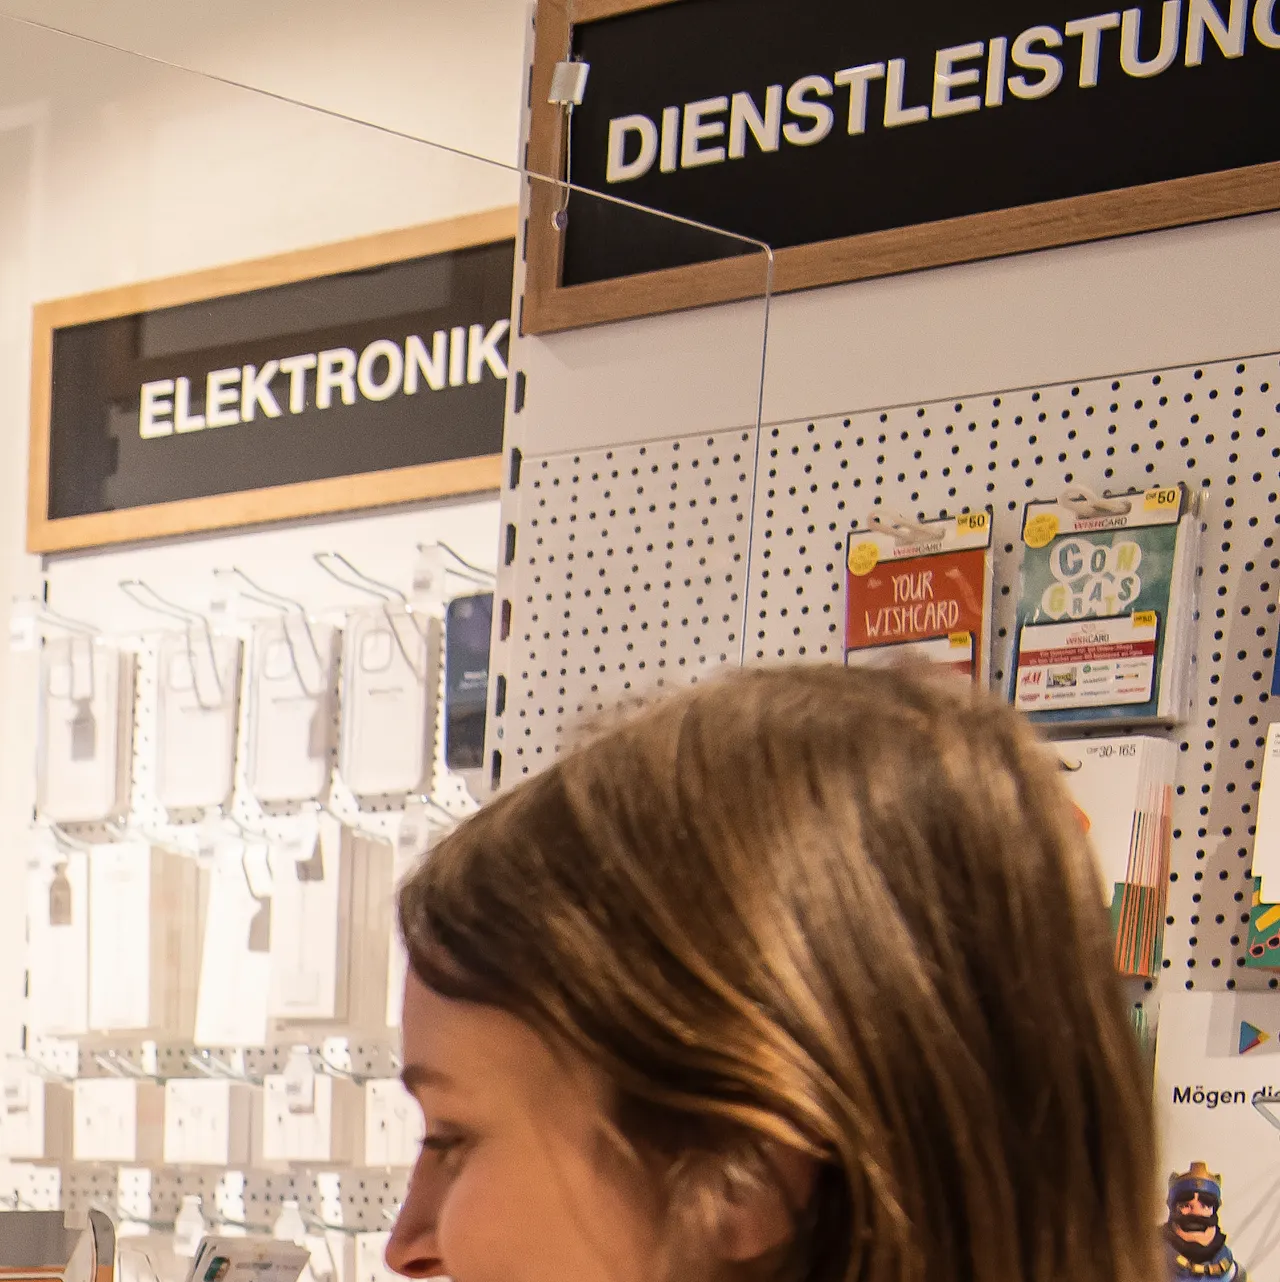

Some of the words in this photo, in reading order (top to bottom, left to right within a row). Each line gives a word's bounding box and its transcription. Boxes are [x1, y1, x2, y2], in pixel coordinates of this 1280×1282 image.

[138, 318, 513, 441] ELEKTRONIK
[1158, 490, 1176, 504] 50
[1074, 517, 1127, 530] WISHCARD
[892, 570, 934, 603] YOUR
[865, 600, 959, 638] WISHCARD
[1173, 1085, 1246, 1108] Mögen
